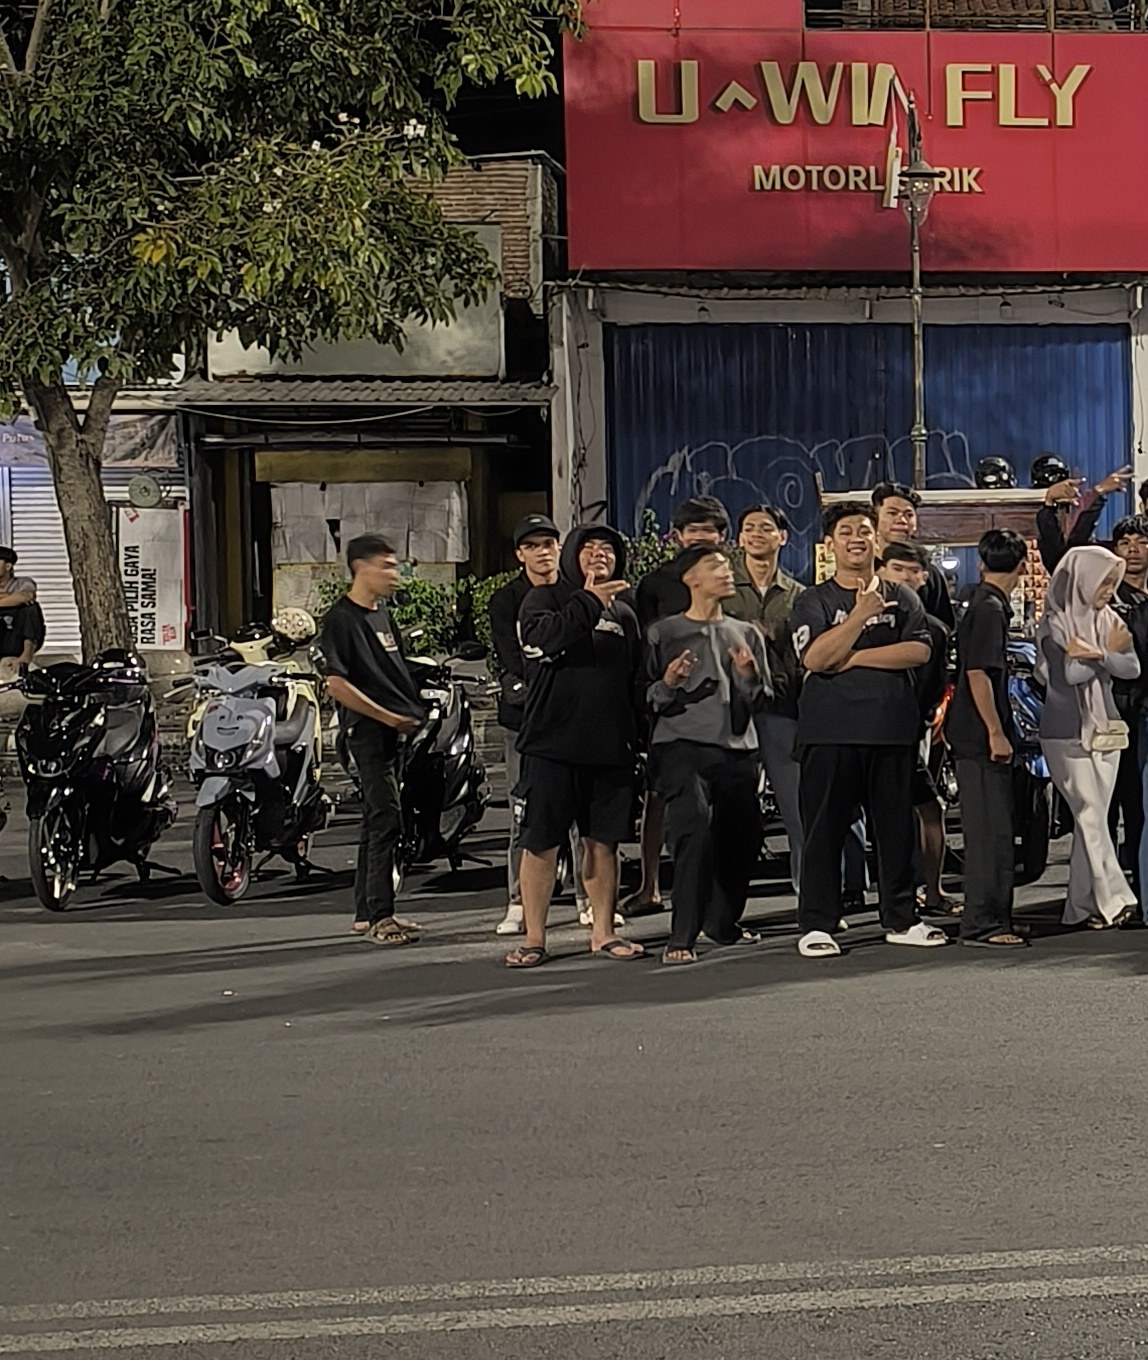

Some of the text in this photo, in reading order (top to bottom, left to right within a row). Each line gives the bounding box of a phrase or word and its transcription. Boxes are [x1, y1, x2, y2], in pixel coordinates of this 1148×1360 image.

[124, 545, 140, 577] GAYA
[140, 568, 157, 644] RASA SAMA!
